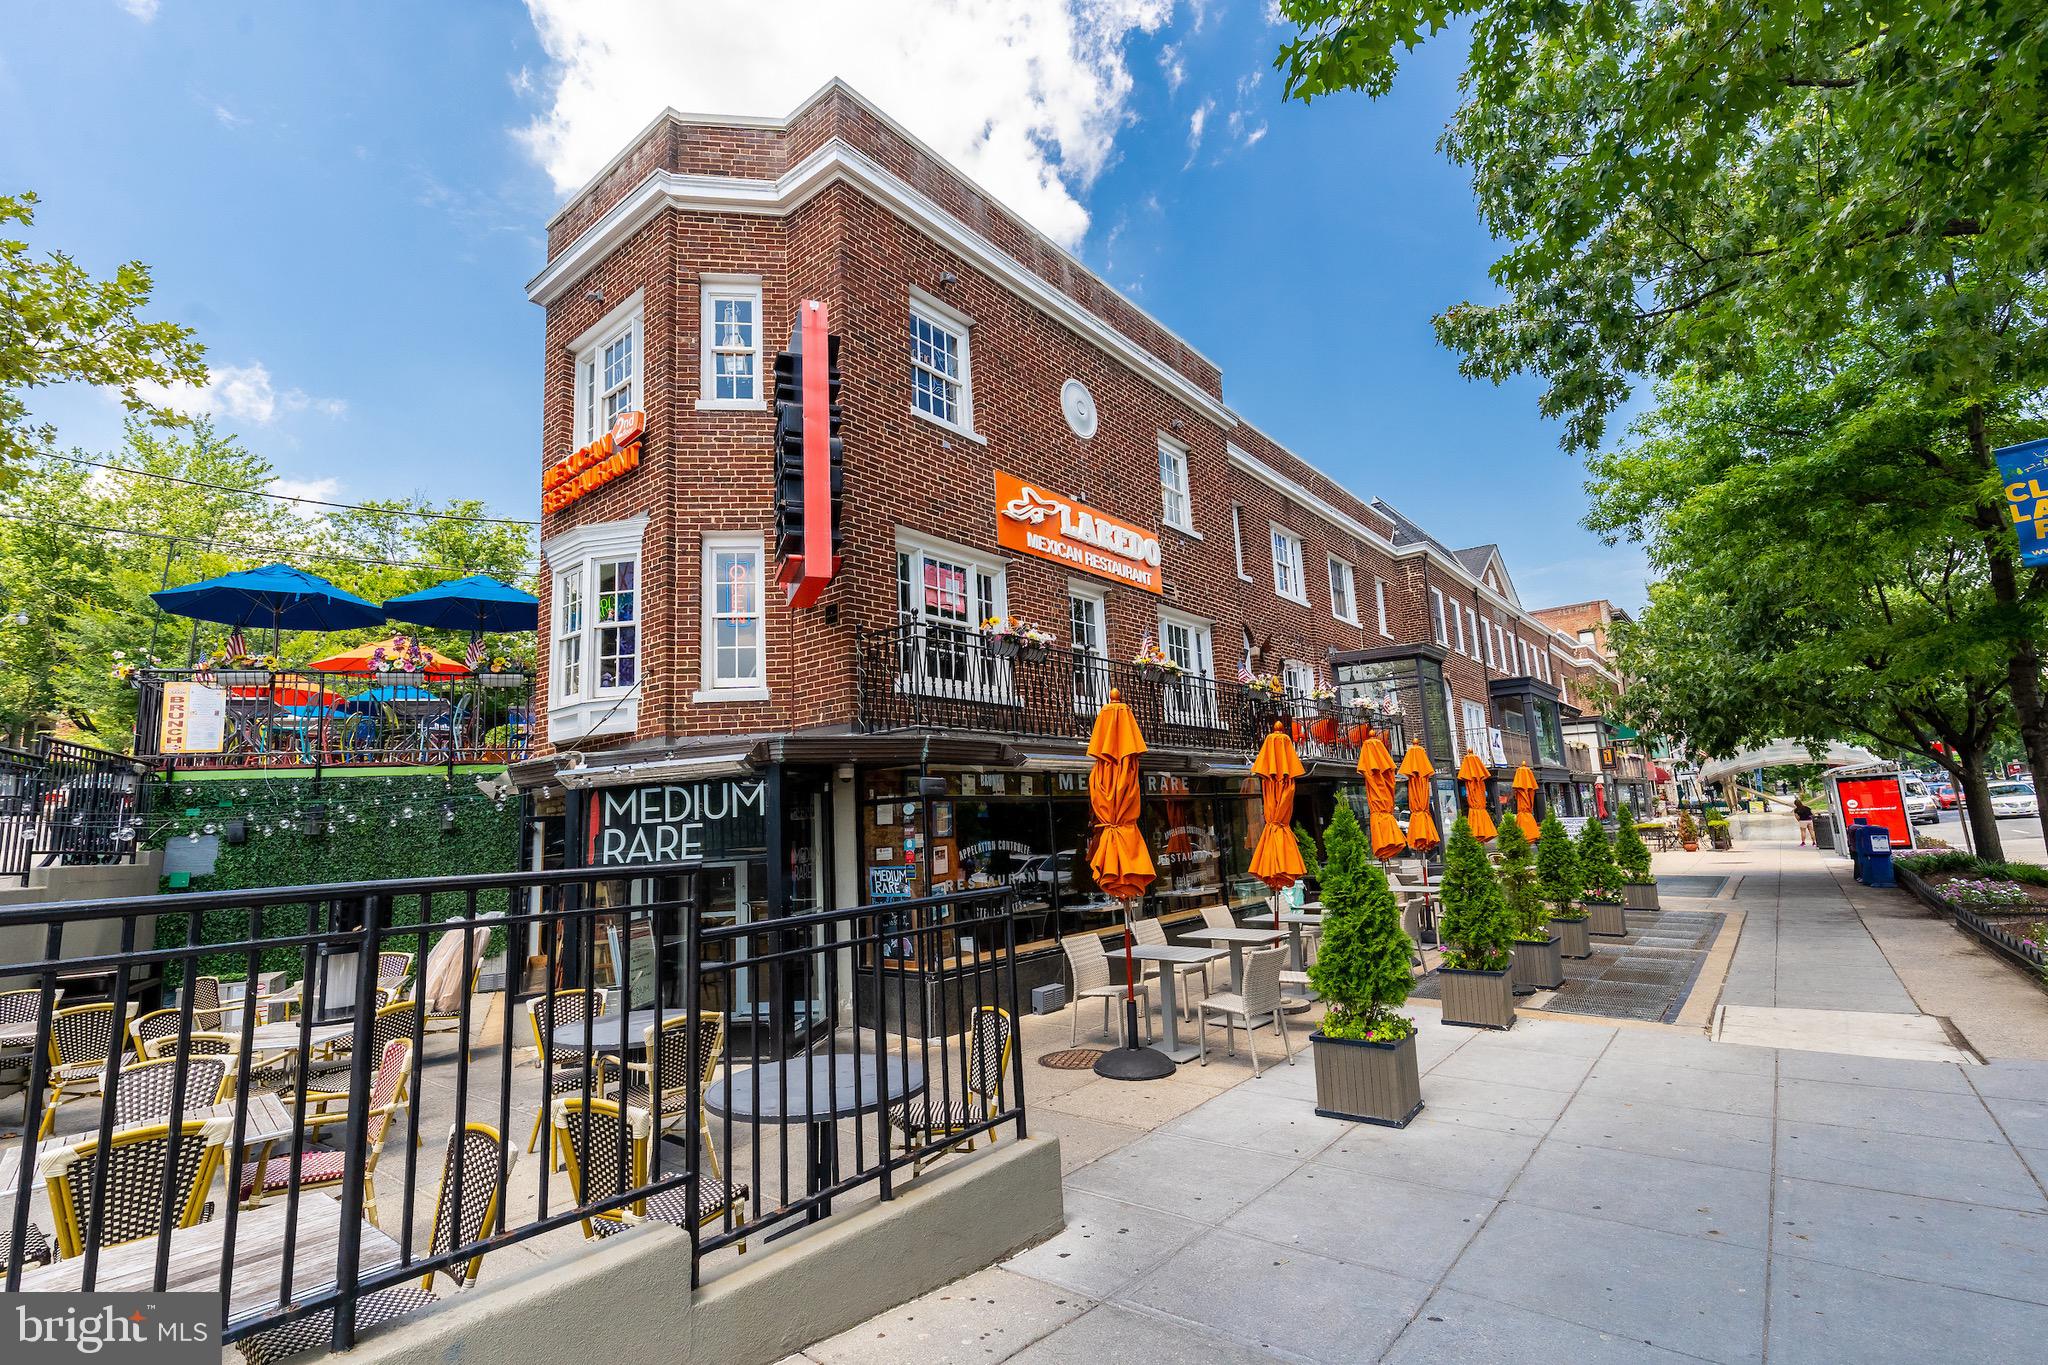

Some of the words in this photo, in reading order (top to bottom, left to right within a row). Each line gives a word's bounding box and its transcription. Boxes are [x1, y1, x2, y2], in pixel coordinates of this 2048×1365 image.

[1058, 504, 1162, 567] LAREDO
[1026, 531, 1083, 564] MEXICAN
[1085, 551, 1153, 586] RESTAURANT
[166, 696, 185, 744] BRUNCH
[604, 780, 766, 826] MEDIUM
[1147, 775, 1190, 791] RARE
[602, 823, 704, 865] RARE
[874, 869, 907, 883] MEDIUM
[875, 881, 901, 894] RARE
[944, 867, 1037, 892] RESAURAN
